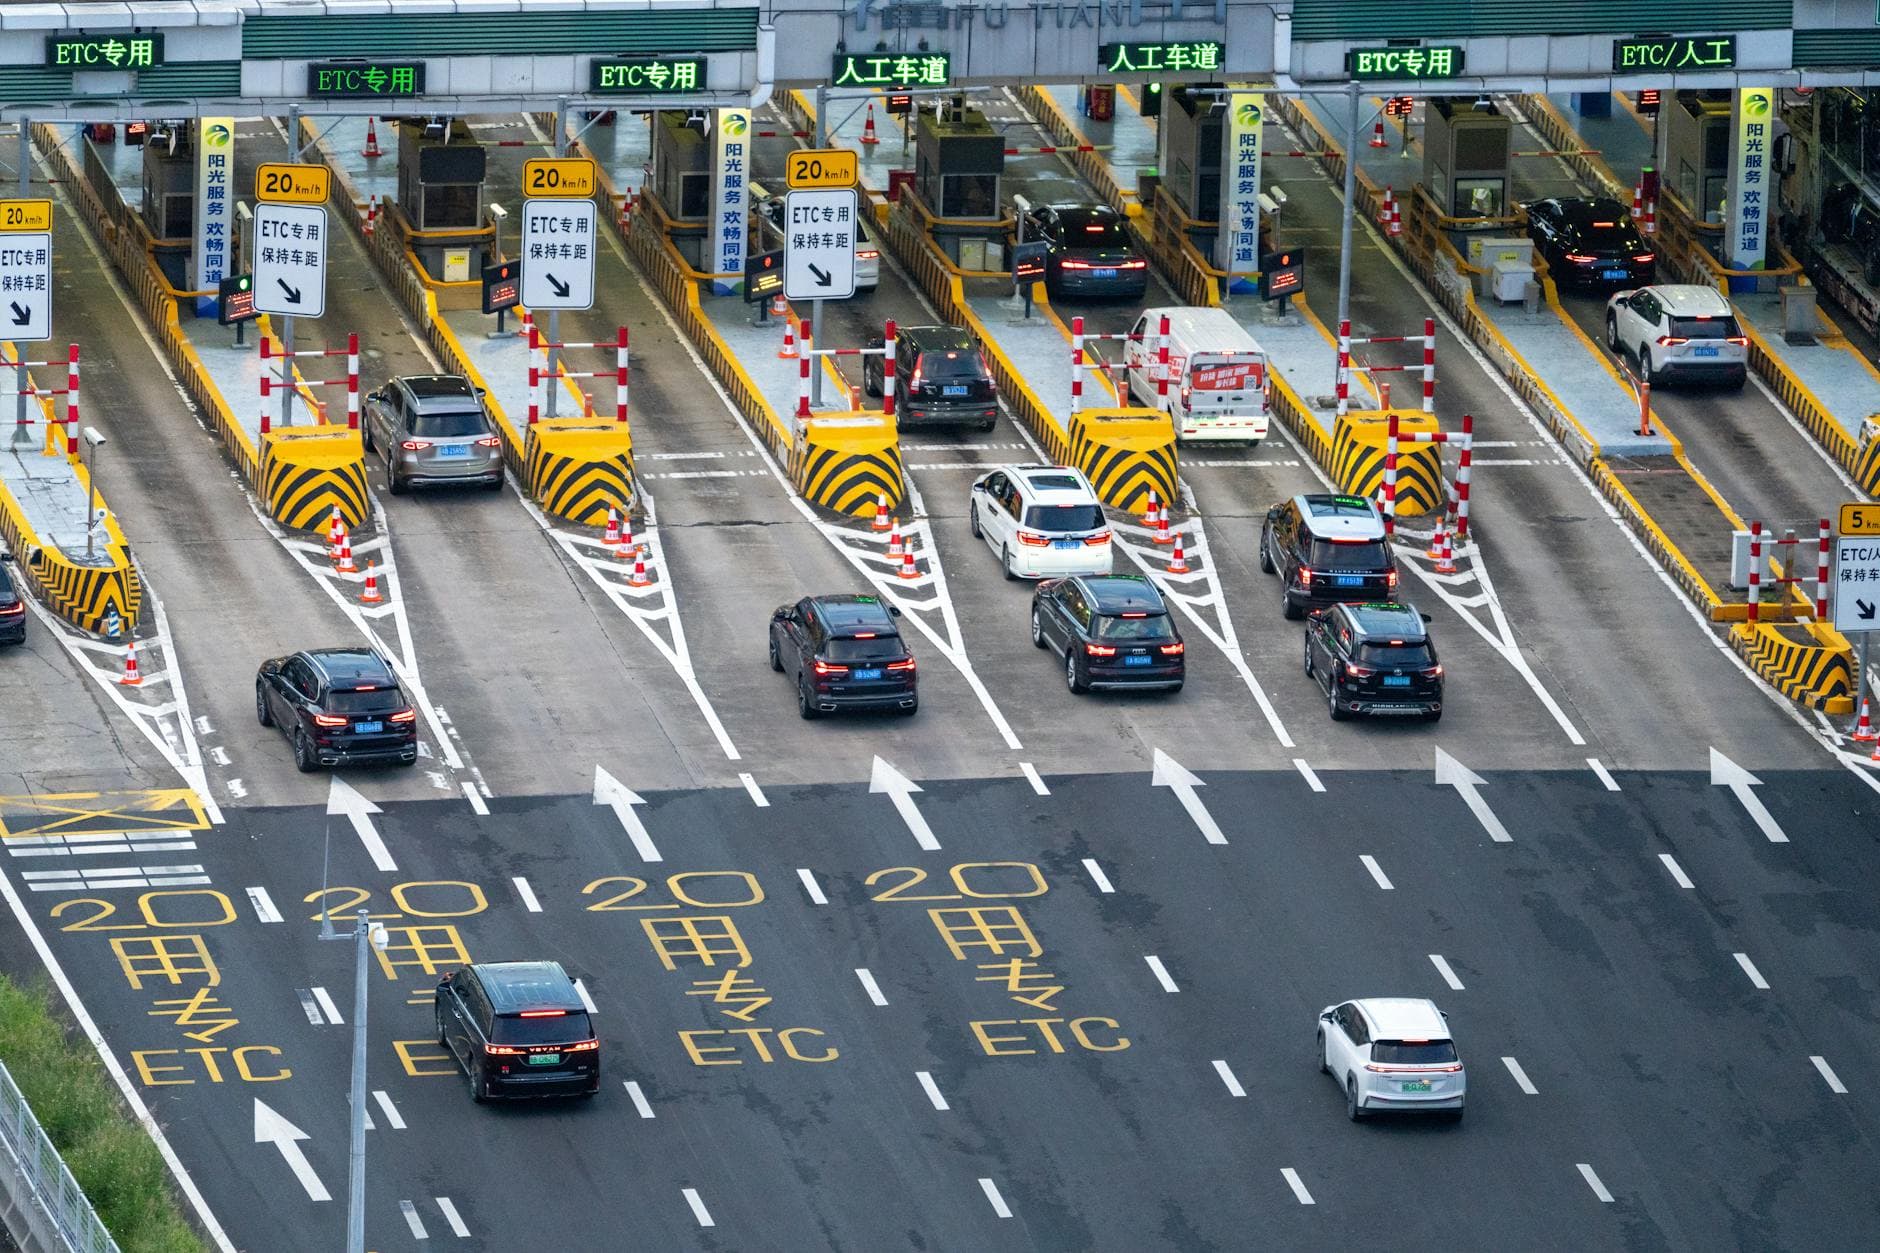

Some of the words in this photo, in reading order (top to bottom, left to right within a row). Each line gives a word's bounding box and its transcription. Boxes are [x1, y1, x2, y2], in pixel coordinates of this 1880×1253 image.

[1029, 1, 1124, 29] TIAN
[56, 39, 153, 66] ETC专用
[1109, 42, 1219, 73] 人工车道
[1356, 48, 1453, 76] ETC专用
[1621, 39, 1736, 68] ETC/人工
[318, 66, 415, 93] ETC专用
[599, 61, 698, 90] ETC专用
[837, 54, 948, 85] 人工车道
[1237, 132, 1257, 195] 阳光服务
[1744, 122, 1764, 184] 阳光服务
[207, 153, 226, 216] 阳光服务
[265, 172, 293, 194] 20
[532, 167, 560, 189] 20
[724, 142, 743, 205] 阳光服务
[795, 159, 823, 181] 20
[7, 207, 23, 225] 20
[261, 219, 320, 242] ETC专用
[530, 215, 588, 235] ETC专用
[792, 206, 850, 225] ETC专用
[1740, 189, 1760, 251] 欢畅同道
[205, 221, 224, 285] 欢畅同道
[530, 243, 588, 261] 保持车距
[722, 210, 741, 272] 欢畅同道
[792, 233, 849, 250] 保持车距
[2, 249, 47, 267] ETC专用
[261, 247, 319, 267] 保持车距
[2, 274, 46, 292] 保持车距
[1851, 511, 1863, 529] 5
[582, 871, 765, 911] 20
[864, 861, 1049, 901] 20
[50, 890, 237, 931] 20
[303, 881, 489, 922] 20
[640, 915, 753, 971] 用
[927, 906, 1043, 961] 用
[109, 935, 221, 990] 用
[678, 1027, 840, 1066] ETC
[970, 1016, 1131, 1056] ETC
[130, 1045, 293, 1086] ETC
